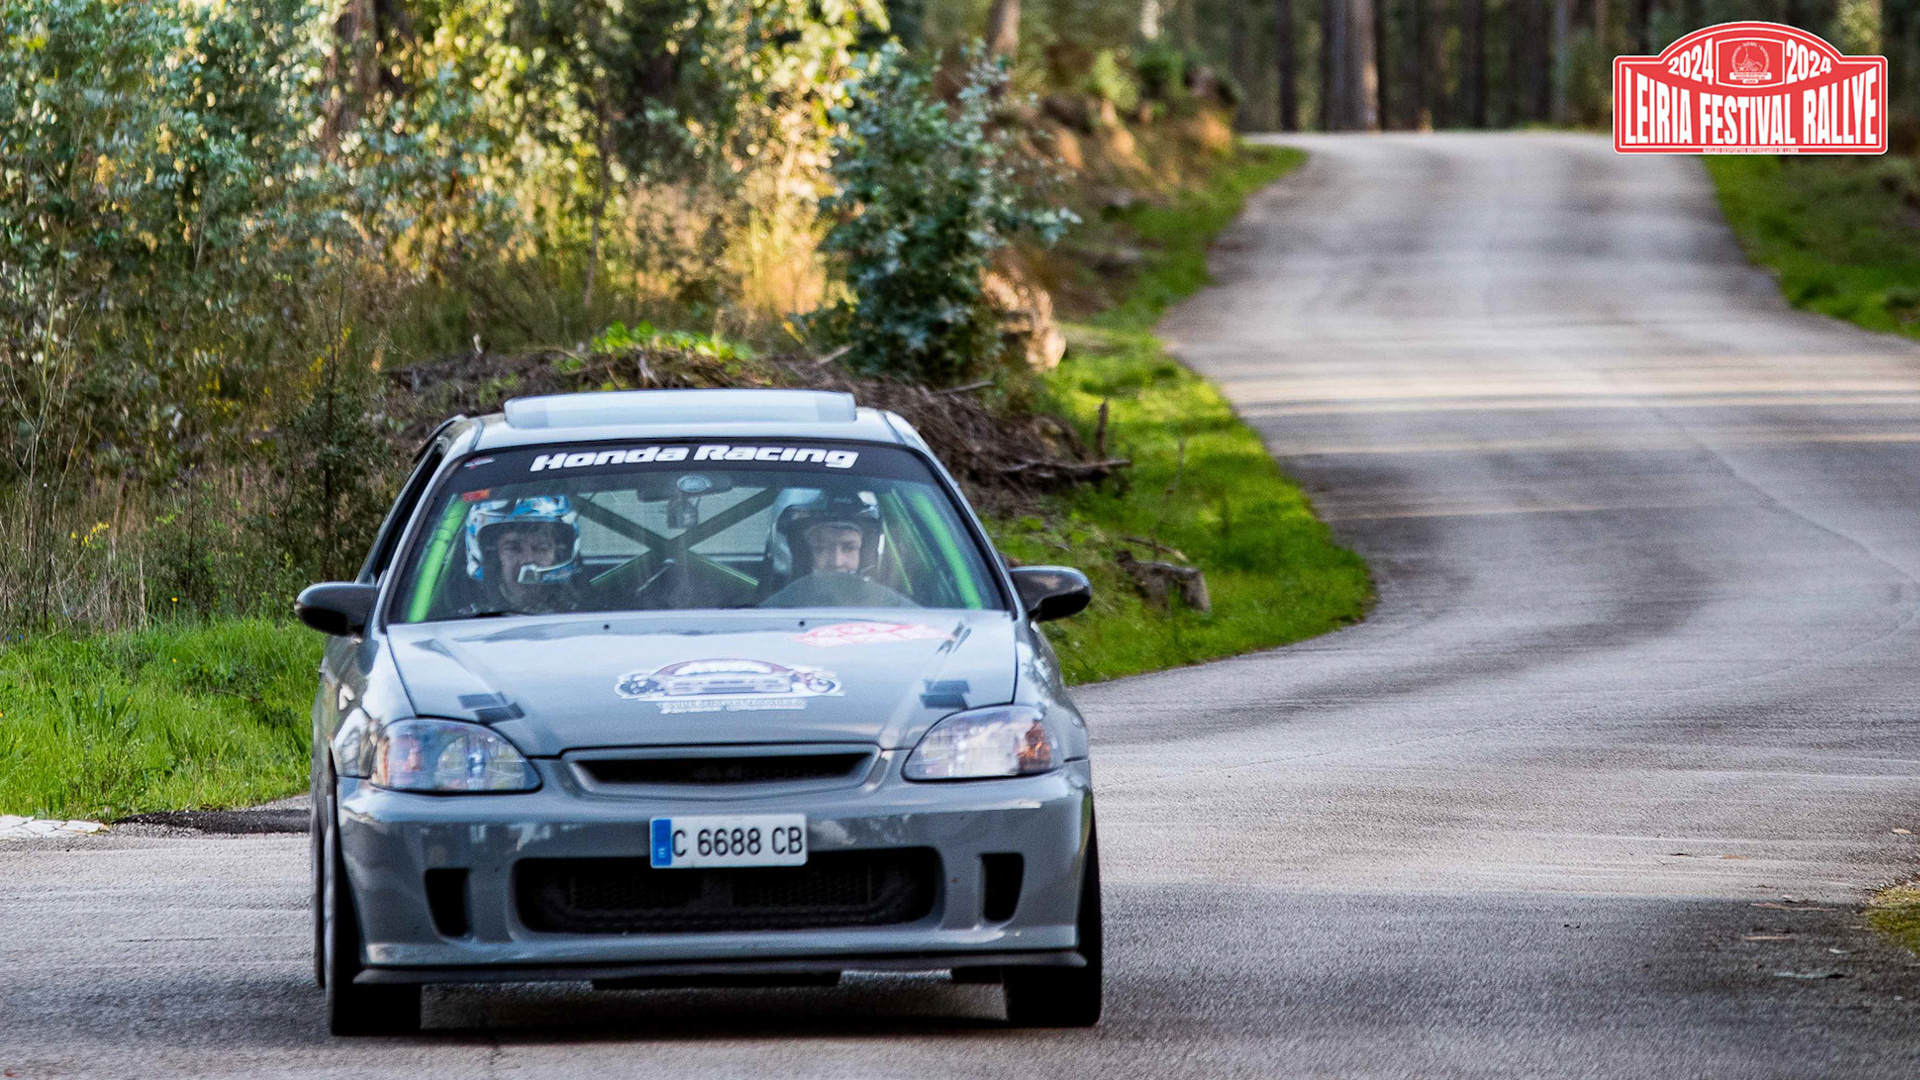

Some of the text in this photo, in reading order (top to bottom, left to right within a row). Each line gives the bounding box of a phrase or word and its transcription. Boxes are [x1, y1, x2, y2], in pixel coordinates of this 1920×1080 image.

[529, 444, 860, 472] Honda Racing
[672, 826, 803, 857] C 6688 CB
